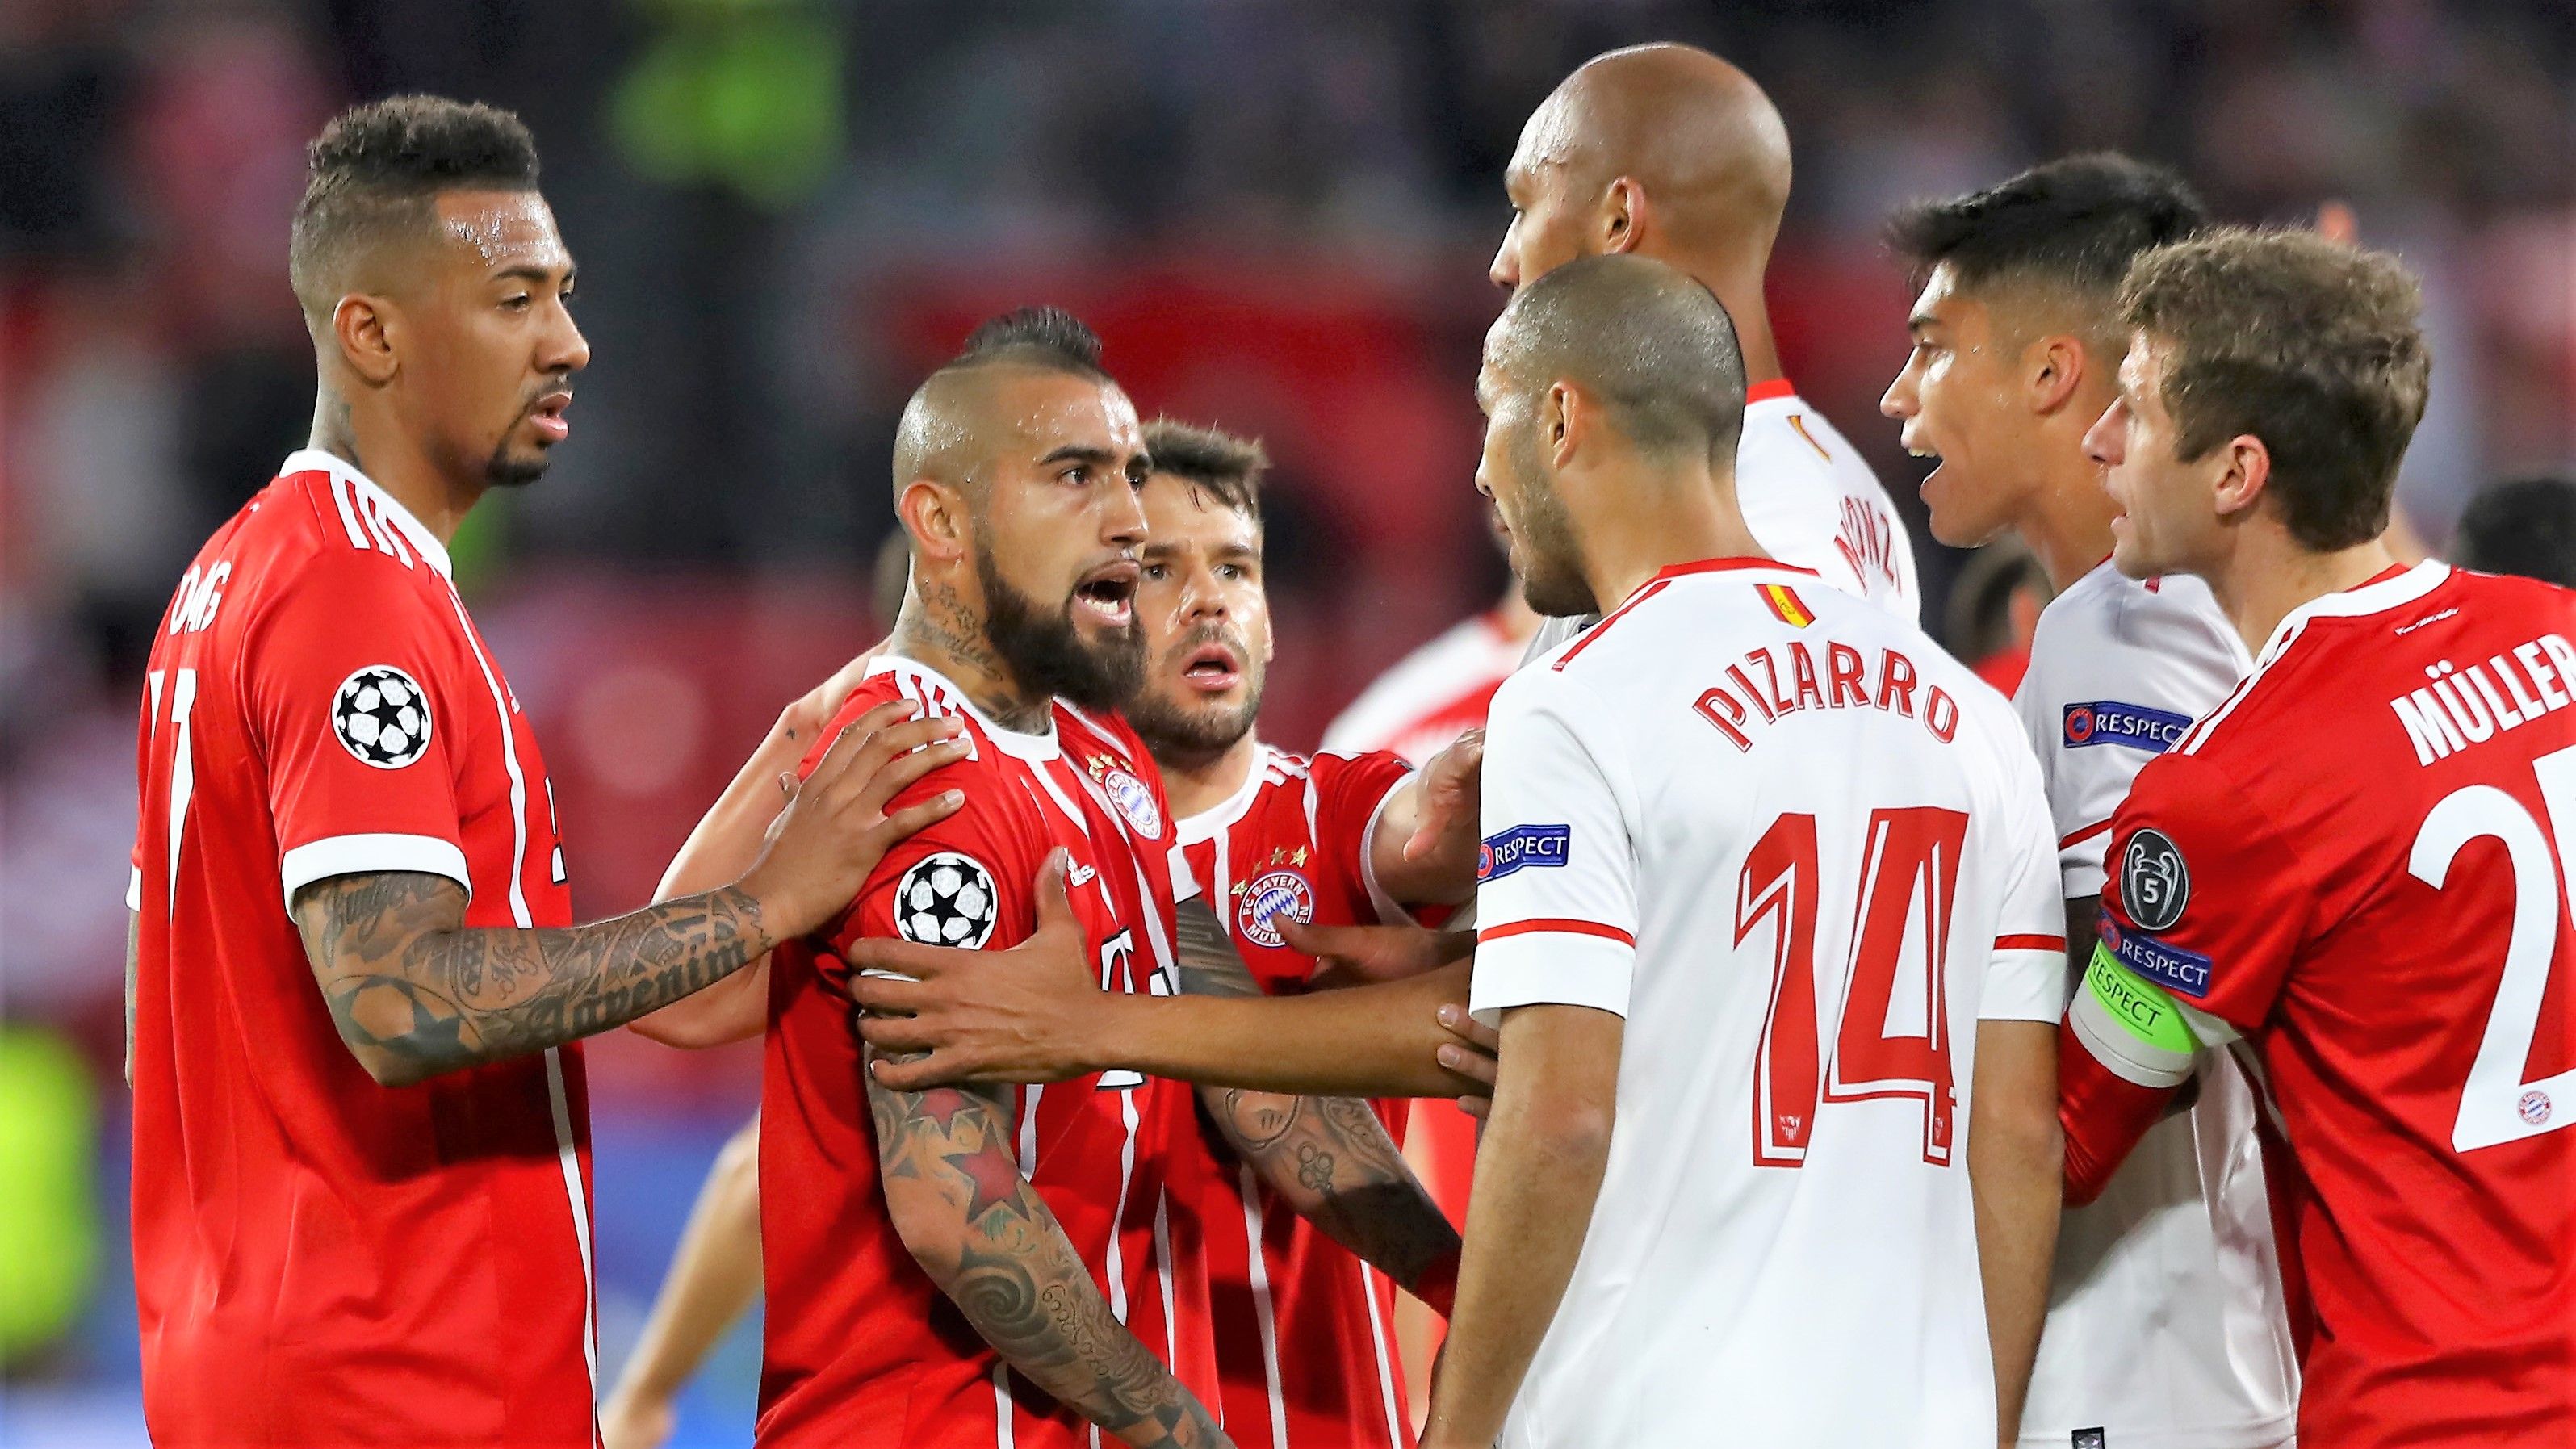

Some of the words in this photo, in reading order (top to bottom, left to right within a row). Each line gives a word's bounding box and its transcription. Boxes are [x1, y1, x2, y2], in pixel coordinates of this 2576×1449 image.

[1693, 640, 1959, 753] PIZARRO
[2390, 634, 2576, 768] MÜLLER
[1494, 836, 1567, 866] RESPECT
[1242, 898, 1254, 915] FC
[1251, 876, 1305, 897] BAYERN
[2142, 877, 2160, 904] 5
[2122, 938, 2209, 986] RESPECT
[2408, 743, 2576, 1154] 2
[1732, 806, 1970, 1168] 14
[2091, 953, 2162, 1028] RESPECT
